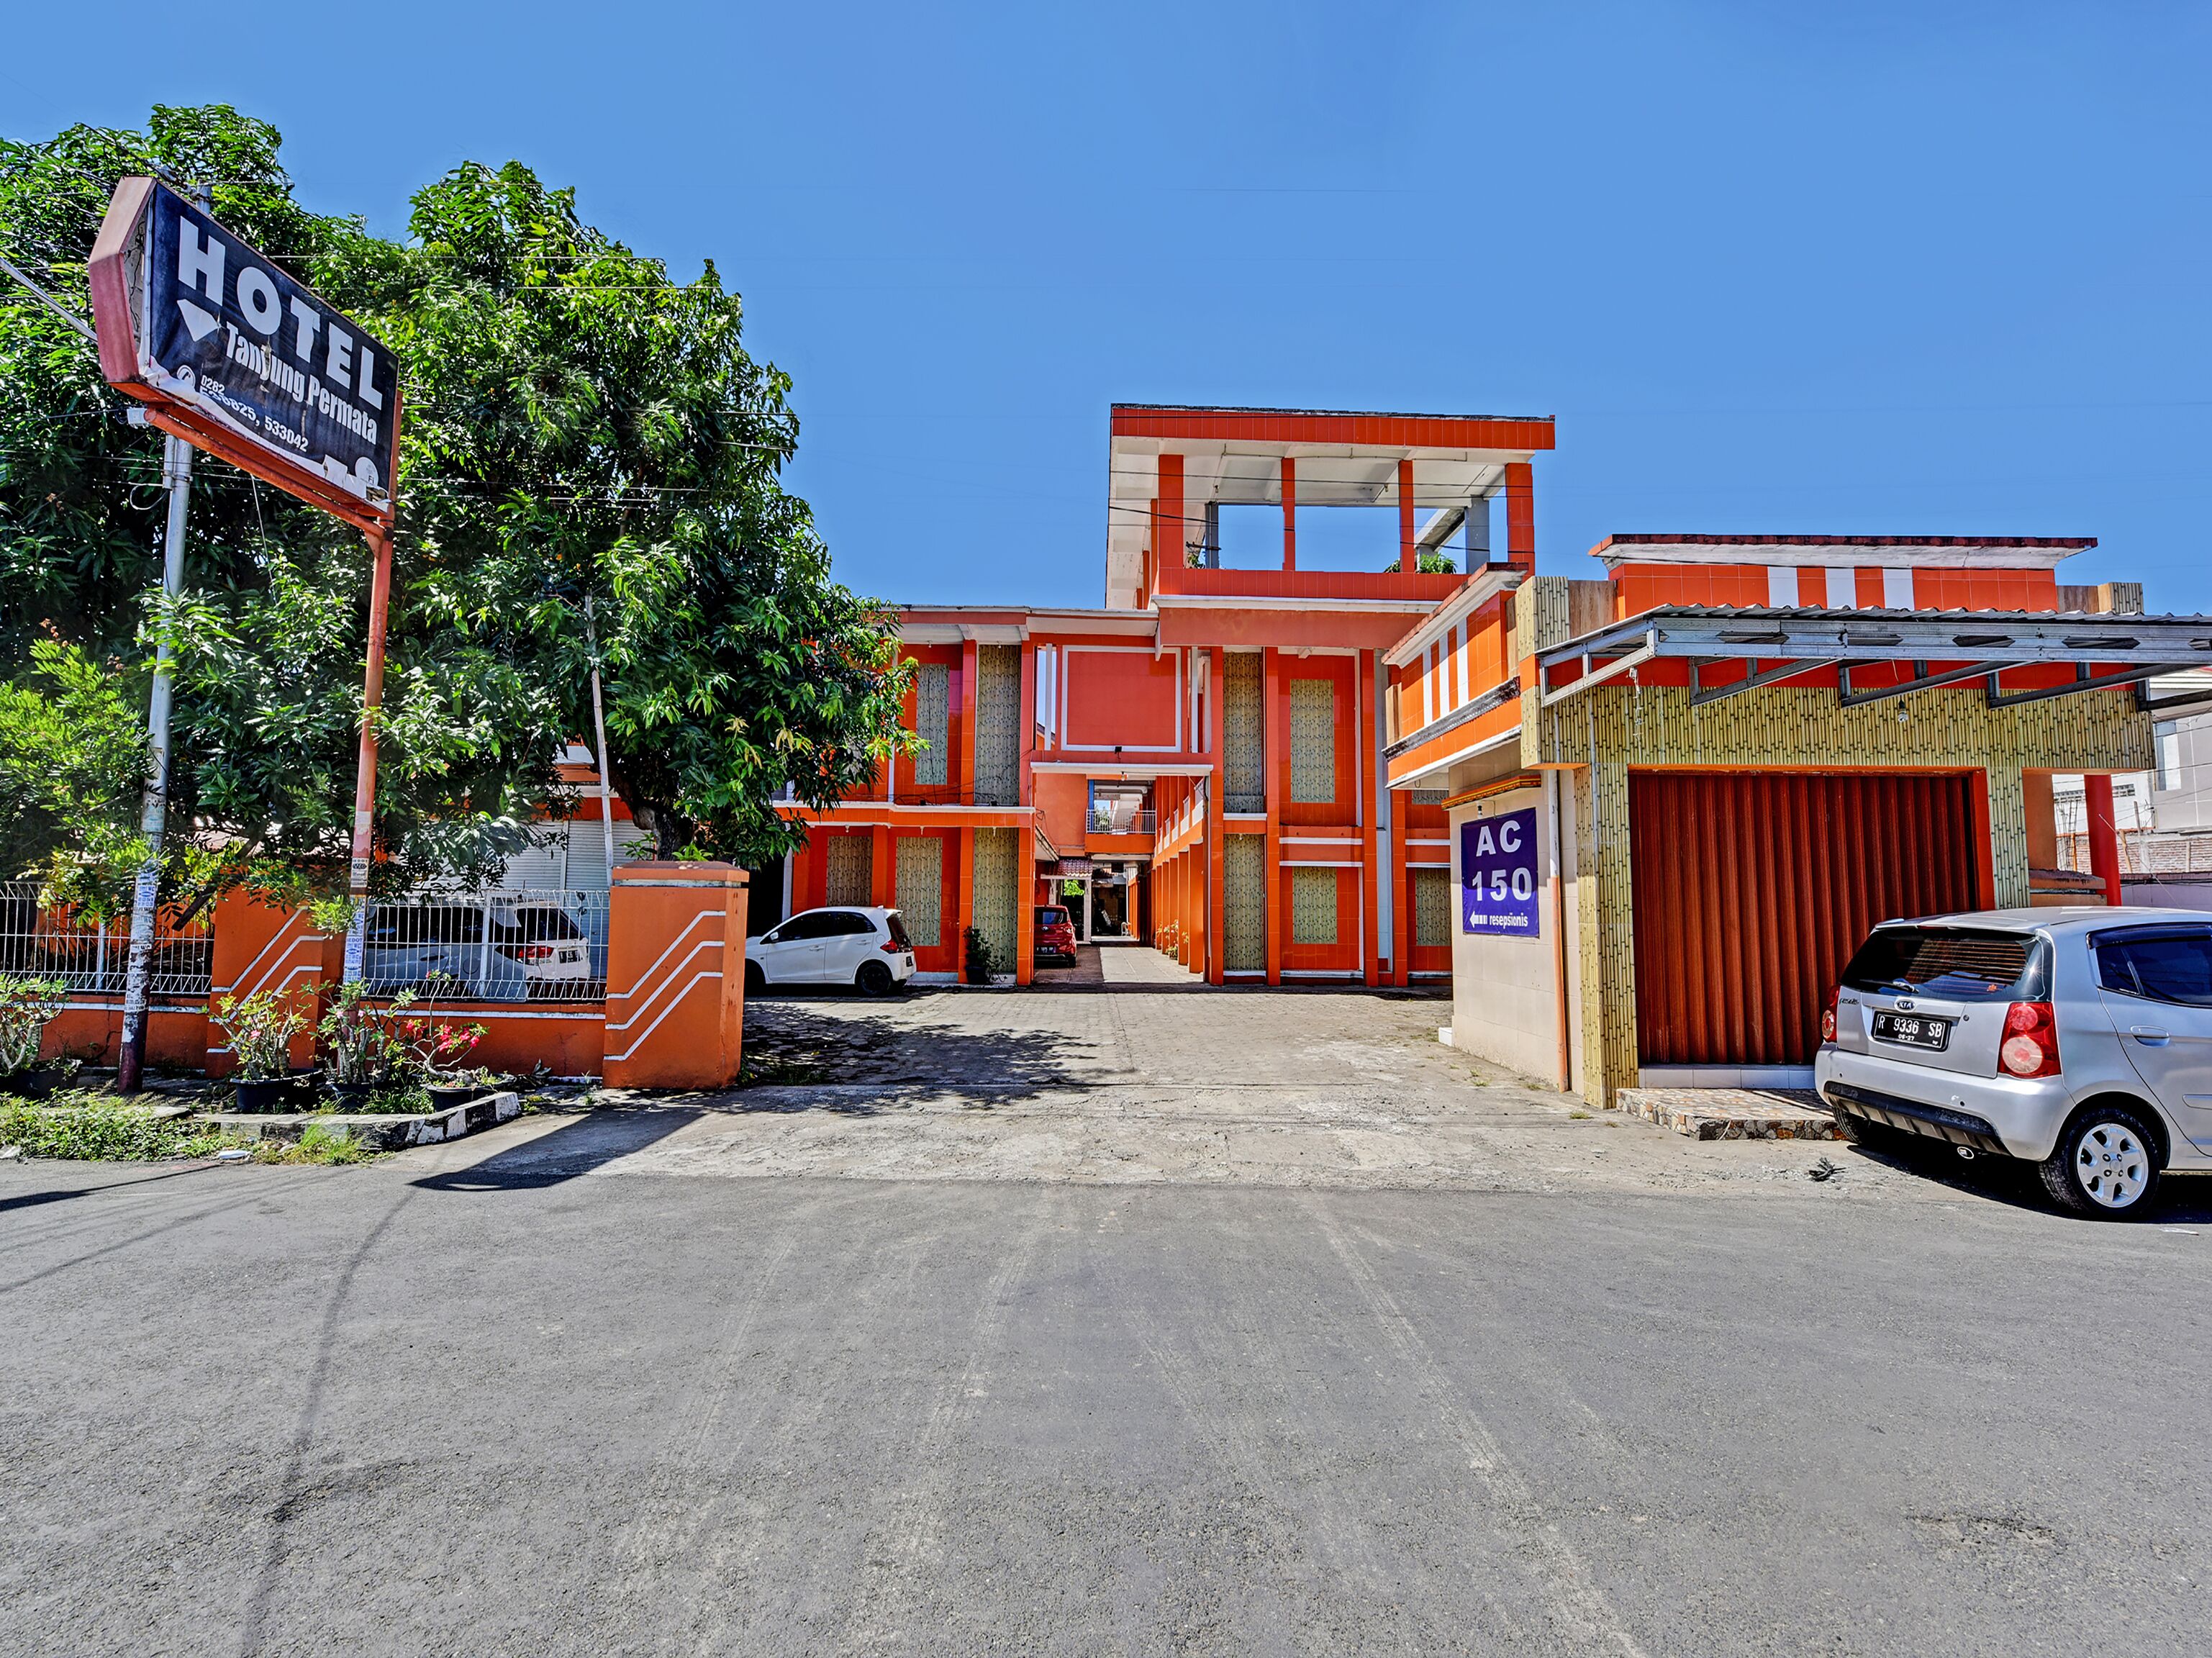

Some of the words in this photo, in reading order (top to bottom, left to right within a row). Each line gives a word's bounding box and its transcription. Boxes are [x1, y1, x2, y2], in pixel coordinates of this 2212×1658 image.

[178, 216, 382, 410] HOTEL
[200, 375, 225, 395] 0282
[227, 322, 305, 403] Tanjung
[307, 374, 377, 445] Permata
[265, 415, 309, 453] 533042
[1476, 820, 1522, 857] AC
[1472, 867, 1533, 902] 150
[1489, 912, 1528, 930] resepsionis
[1878, 1015, 1885, 1030] R
[1893, 1018, 1920, 1034] 9336
[1928, 1023, 1943, 1038] SB
